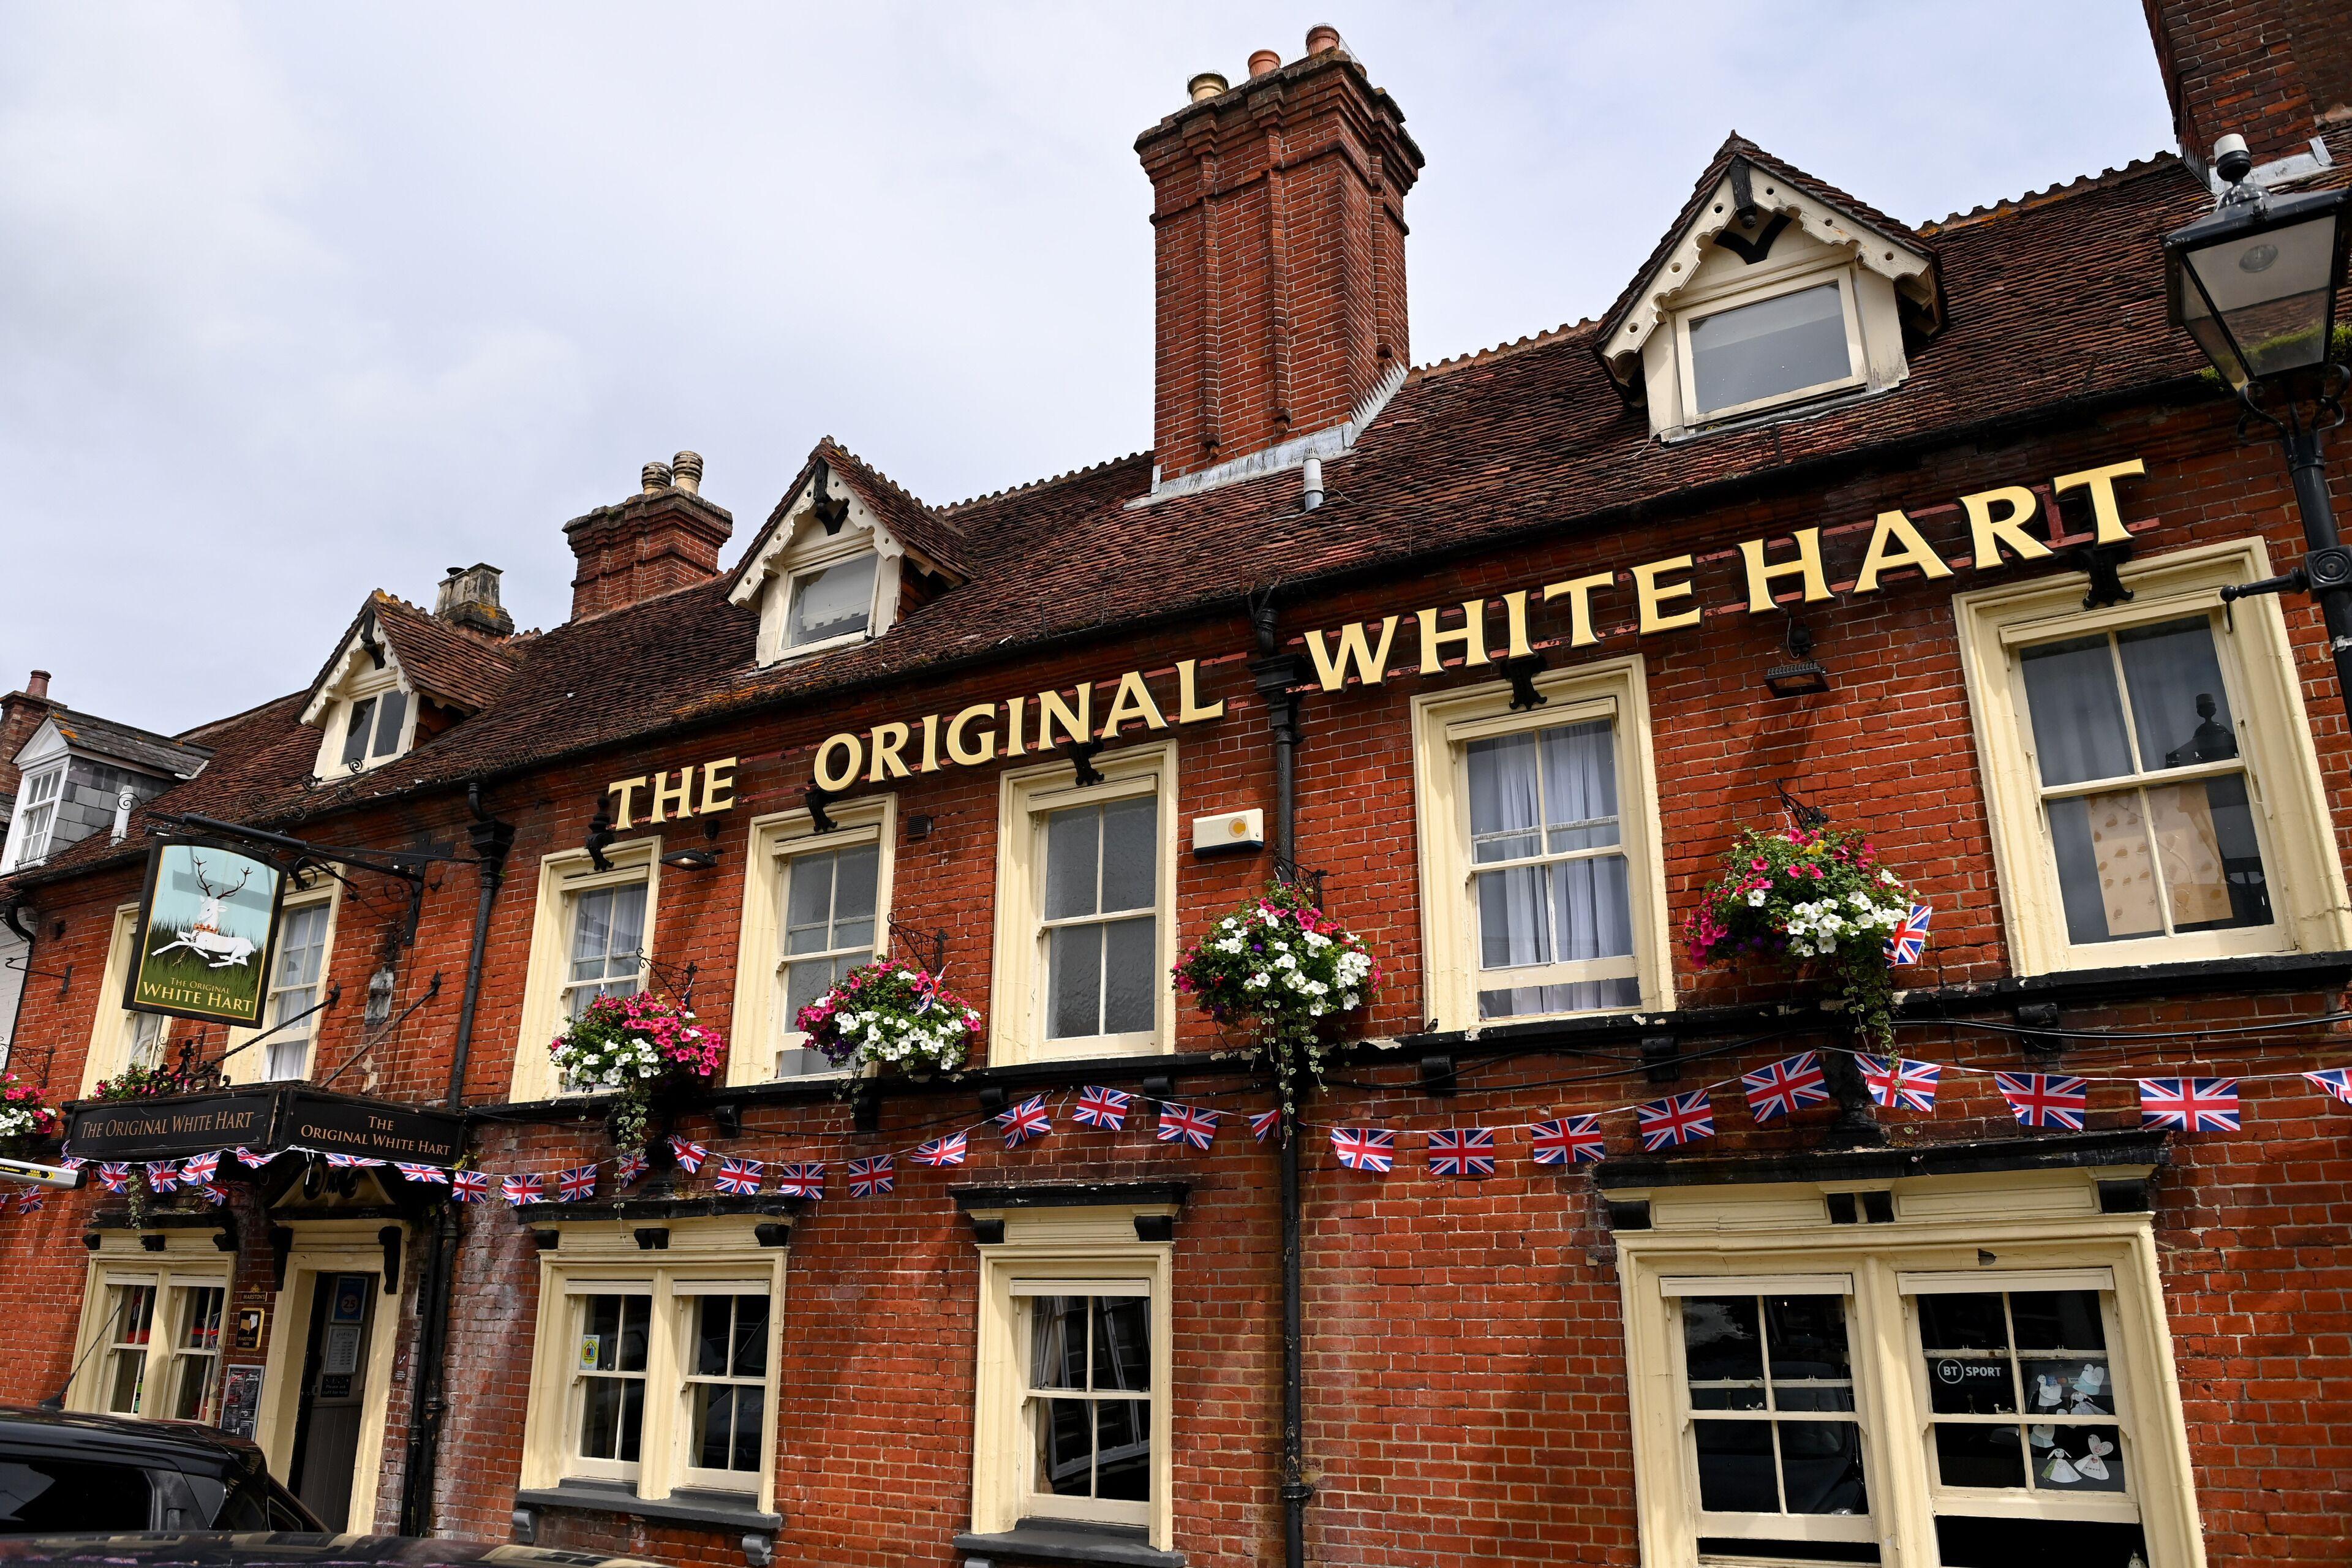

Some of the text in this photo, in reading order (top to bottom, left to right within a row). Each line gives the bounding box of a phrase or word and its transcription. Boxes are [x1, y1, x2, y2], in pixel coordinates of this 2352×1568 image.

[608, 458, 2147, 831] THE ORIGINAL WHITE HART
[143, 981, 253, 1012] WHITE HART
[170, 977, 230, 995] THE ORIGINAL
[81, 1110, 254, 1139] THE ORIGINAL WHITE HART
[368, 1115, 394, 1131] THE
[301, 1124, 451, 1156] ORIGINAL WHITE HART
[343, 1299, 356, 1308] 25
[1943, 1366, 2001, 1377] BT SPORT
